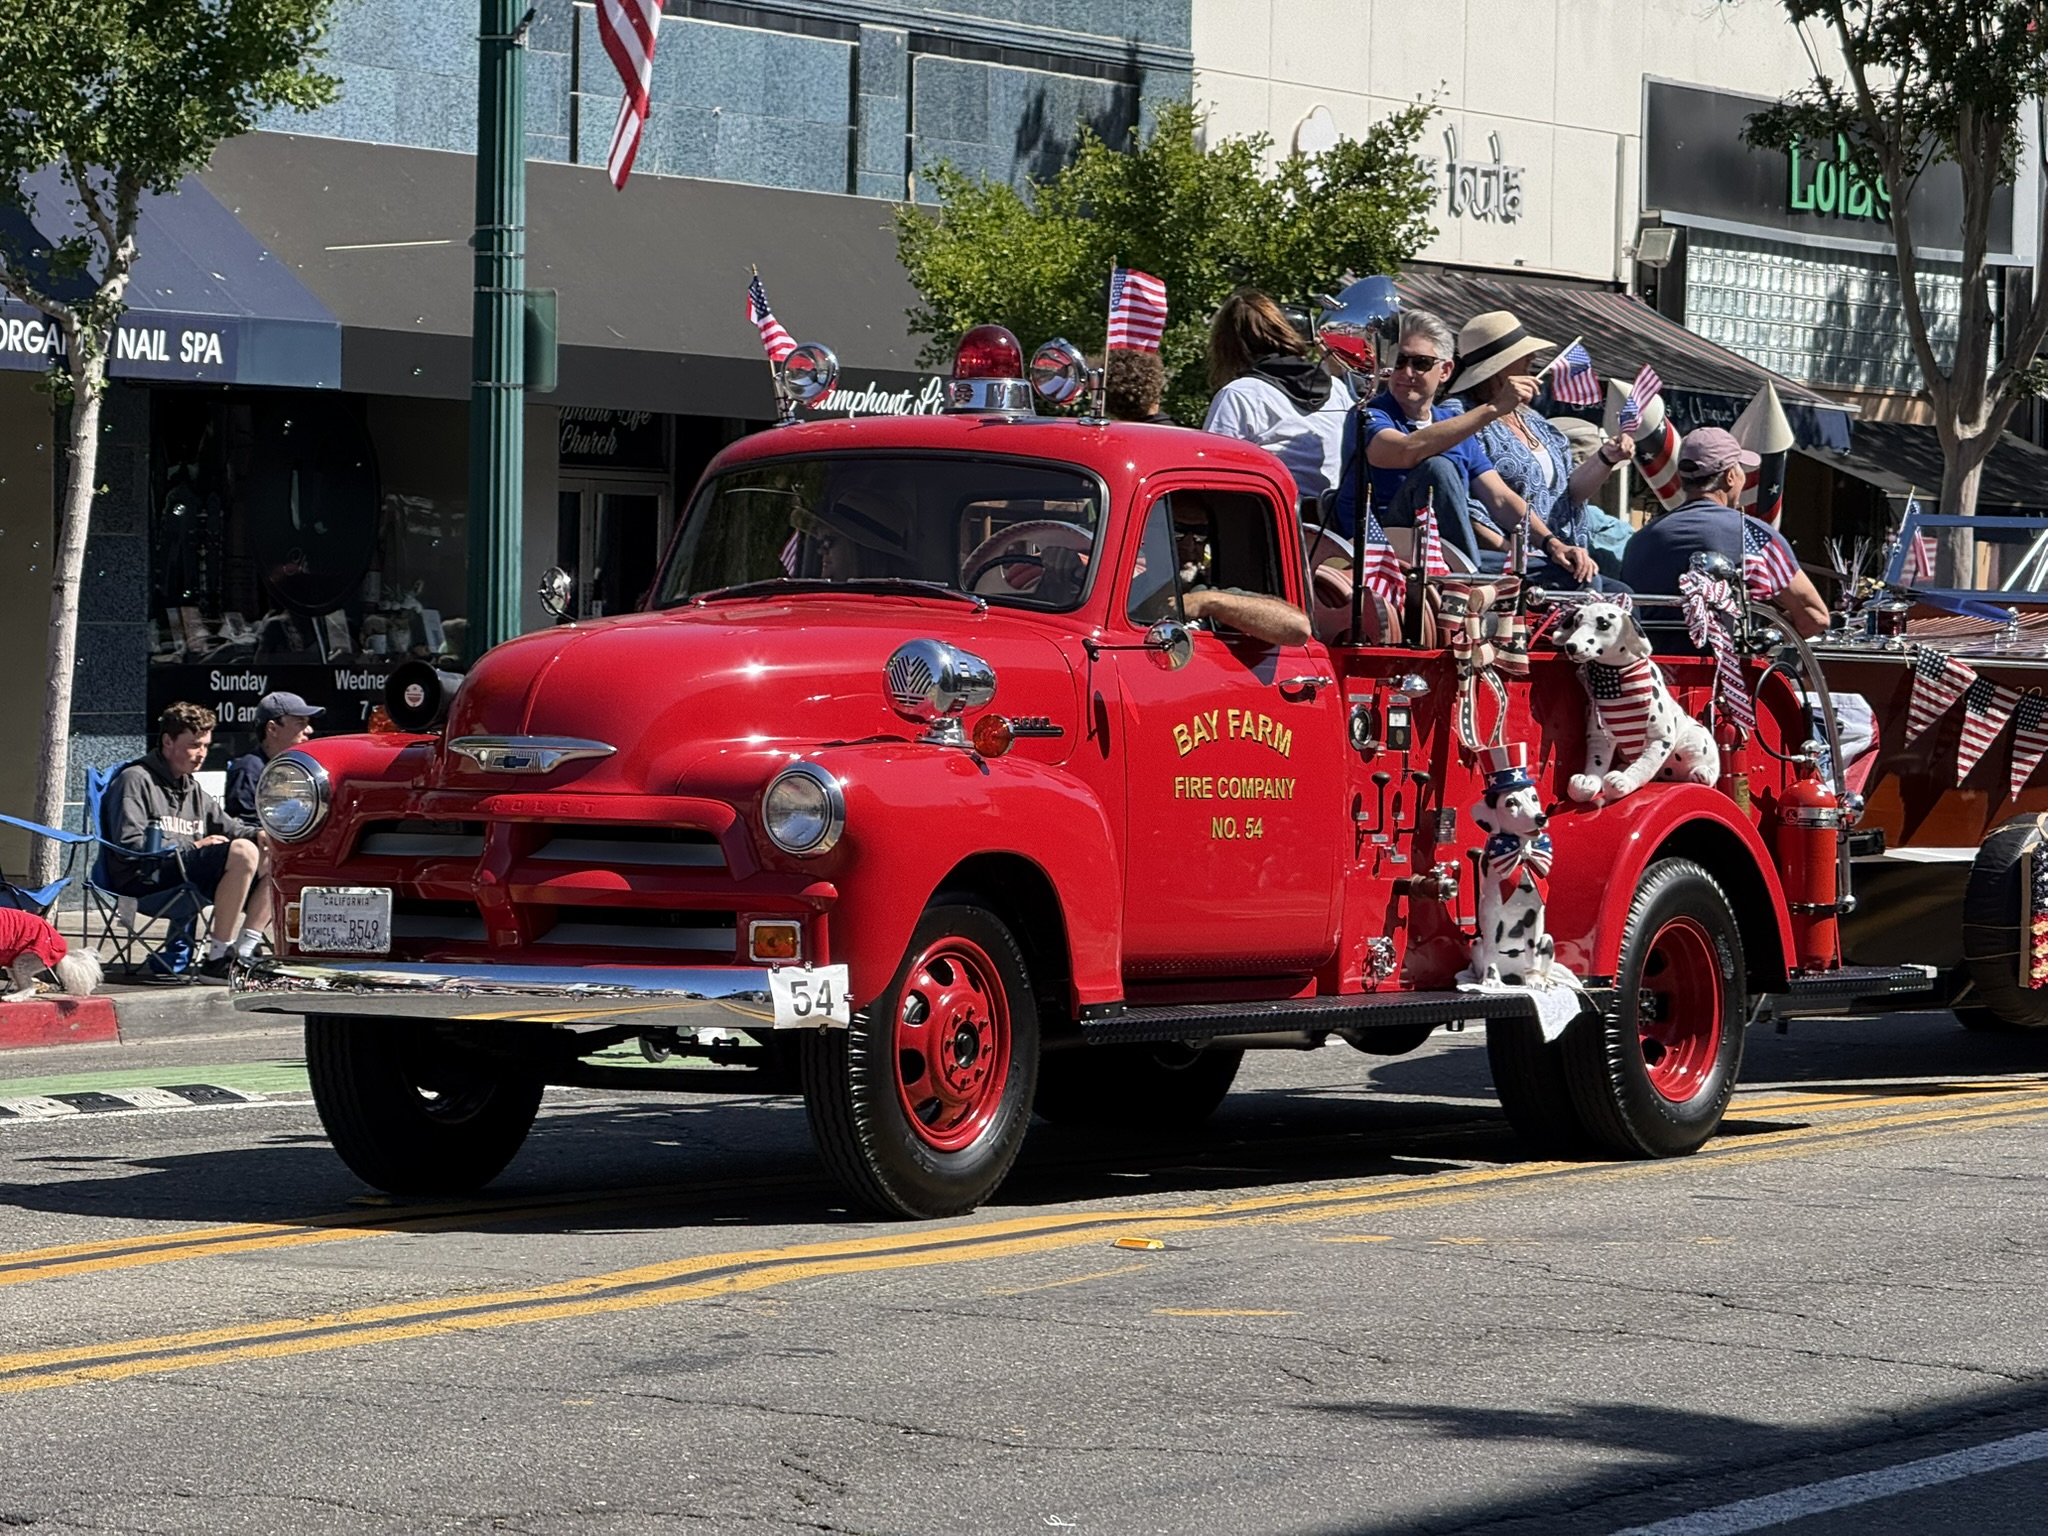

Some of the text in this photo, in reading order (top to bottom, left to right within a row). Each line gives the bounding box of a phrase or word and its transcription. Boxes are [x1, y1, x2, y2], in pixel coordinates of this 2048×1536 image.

[116, 327, 170, 361] NAIL
[180, 330, 223, 364] SPA
[814, 381, 914, 418] umphant
[914, 376, 945, 416] Li
[560, 424, 618, 455] Church
[210, 670, 267, 695] Sunday
[335, 669, 389, 690] Wedne
[215, 701, 234, 722] 10
[359, 700, 369, 720] 7
[1172, 708, 1293, 759] BAY FARM
[1174, 776, 1297, 800] FIRE COMPANY
[488, 798, 596, 815] ROLET
[1211, 816, 1264, 839] NO. 54
[323, 896, 370, 907] CALIFORNIA
[307, 913, 348, 924] HISTORICAL
[306, 926, 337, 937] VEHICLE
[348, 919, 379, 941] B549
[790, 979, 834, 1017] 54
